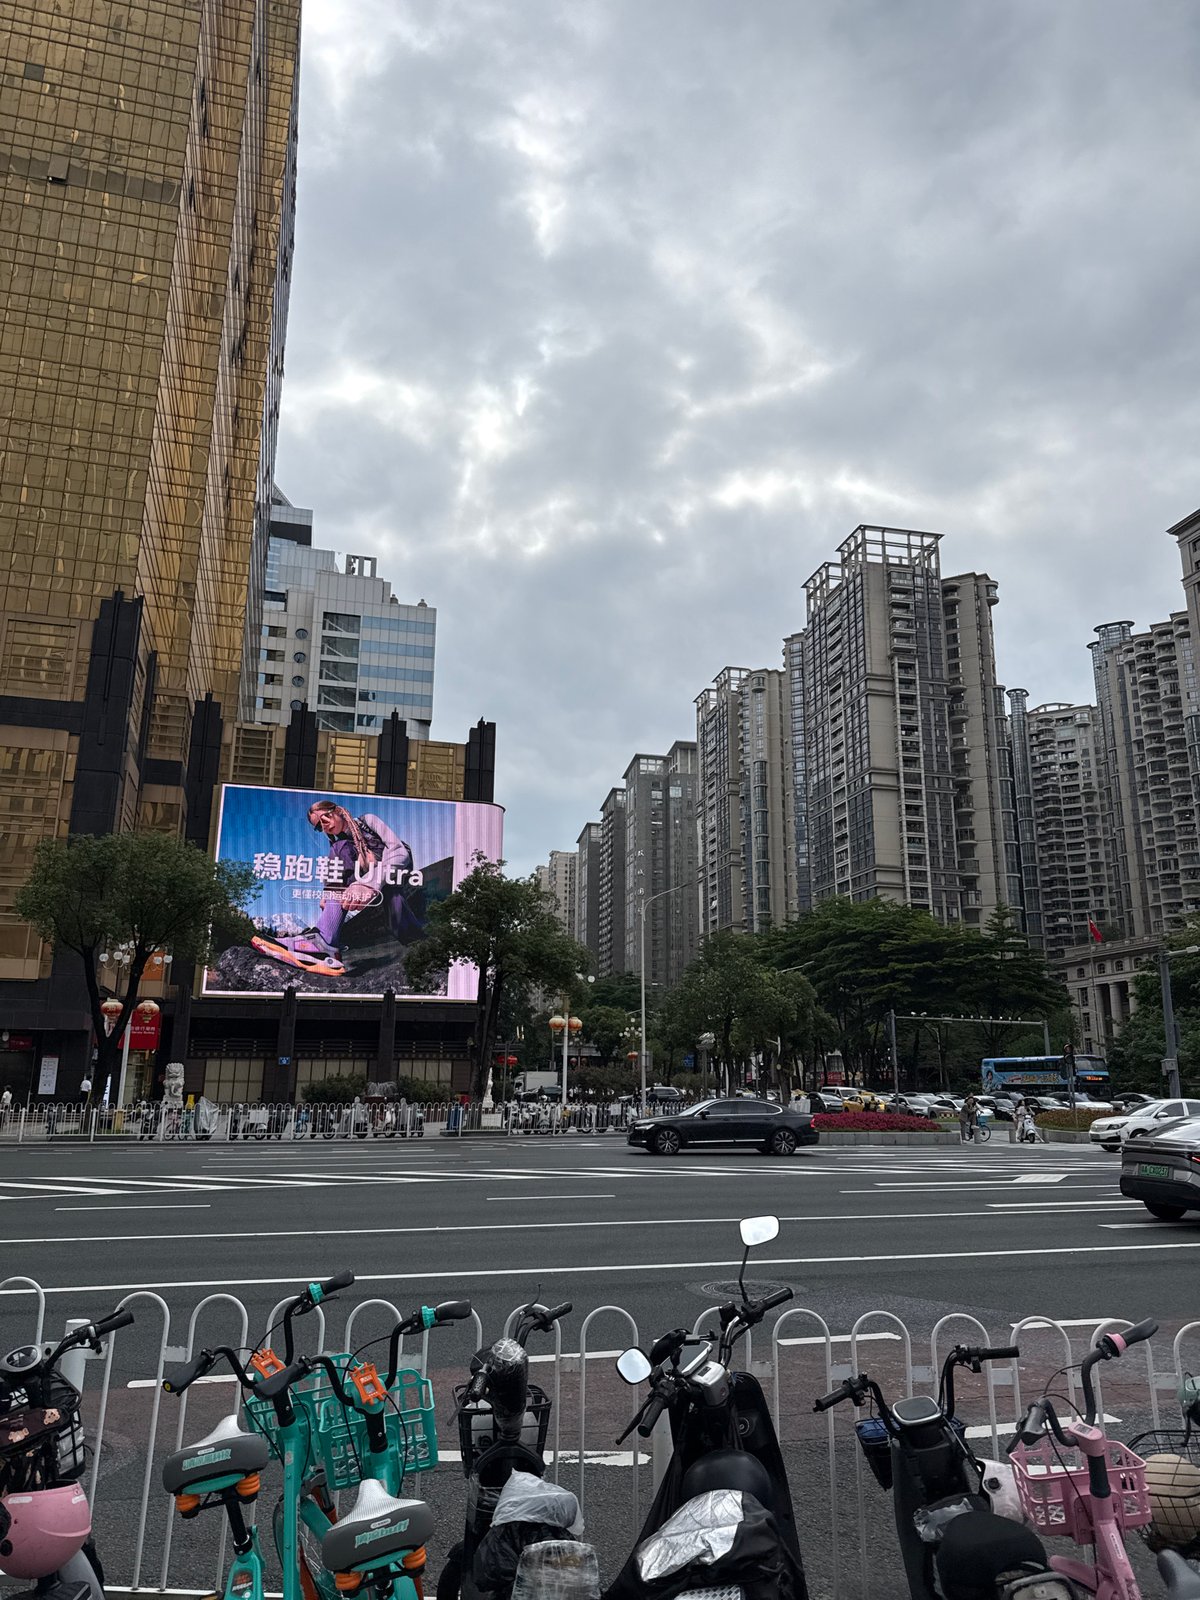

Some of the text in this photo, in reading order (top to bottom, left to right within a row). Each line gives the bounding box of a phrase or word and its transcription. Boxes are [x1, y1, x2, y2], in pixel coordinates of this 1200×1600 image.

[253, 852, 424, 887] 稳跑鞋 Ultra
